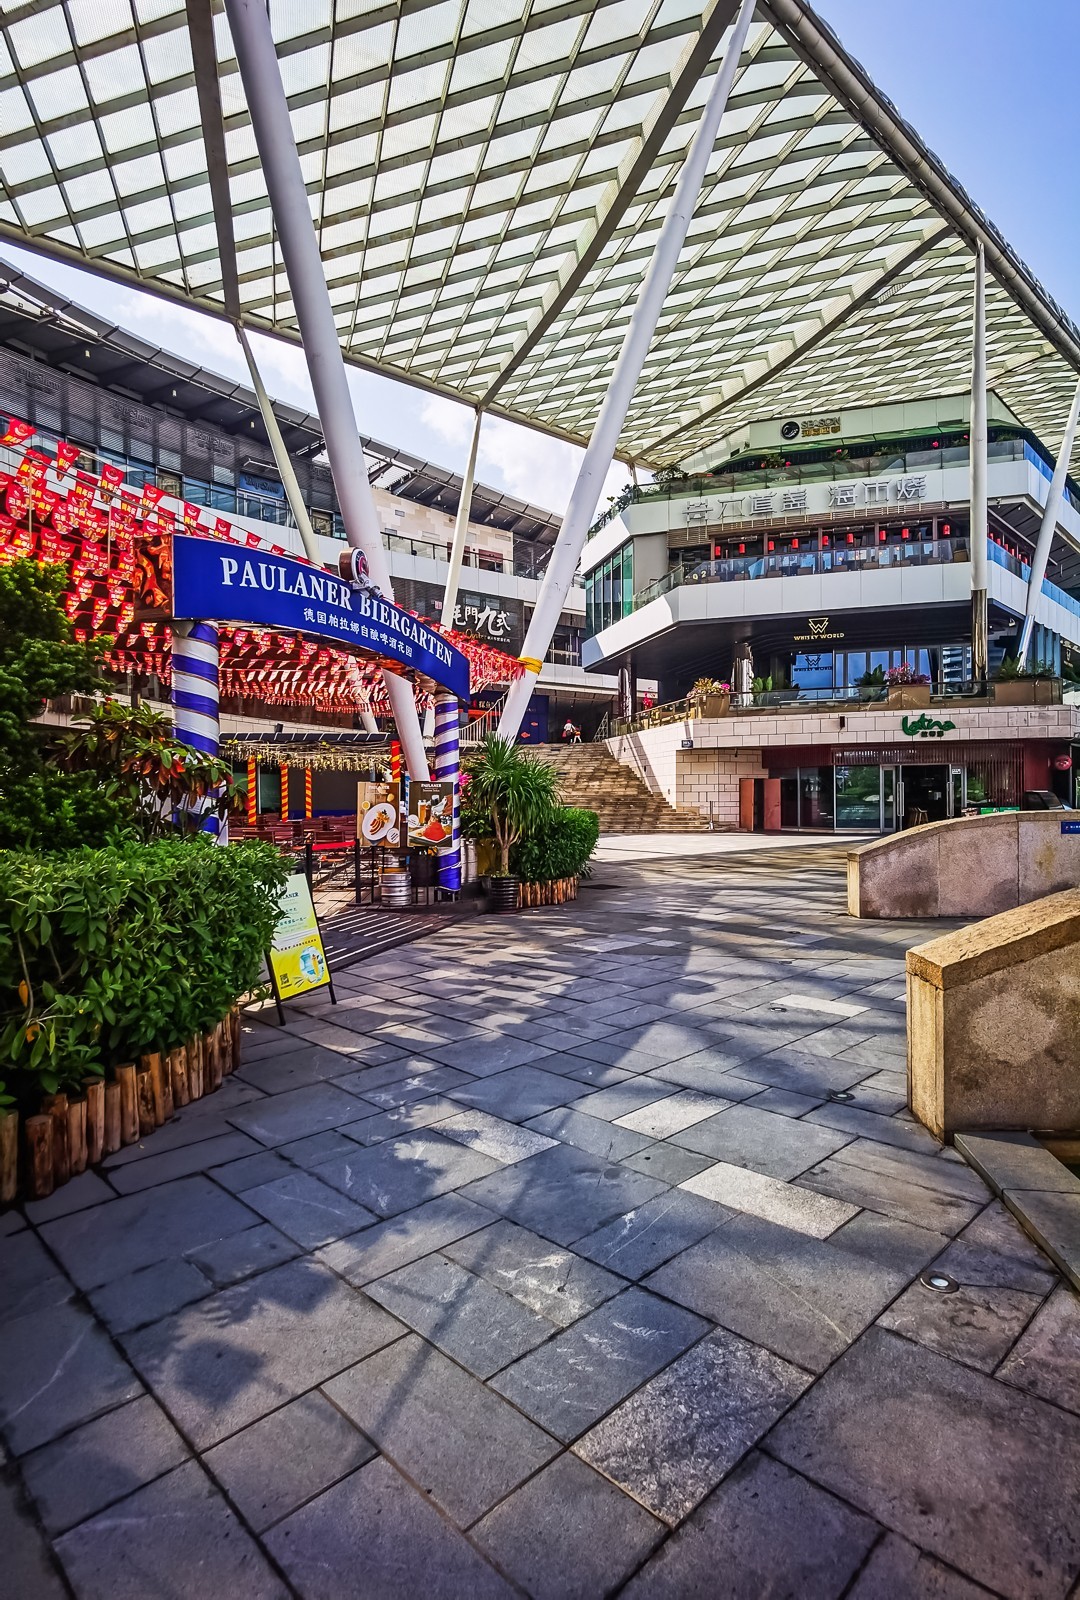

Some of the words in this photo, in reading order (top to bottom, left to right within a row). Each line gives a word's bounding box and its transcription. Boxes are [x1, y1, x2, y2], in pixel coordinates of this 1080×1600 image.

[219, 556, 353, 612] PAULANER
[359, 592, 453, 668] BIERGARTEN
[819, 632, 845, 640] WORLD
